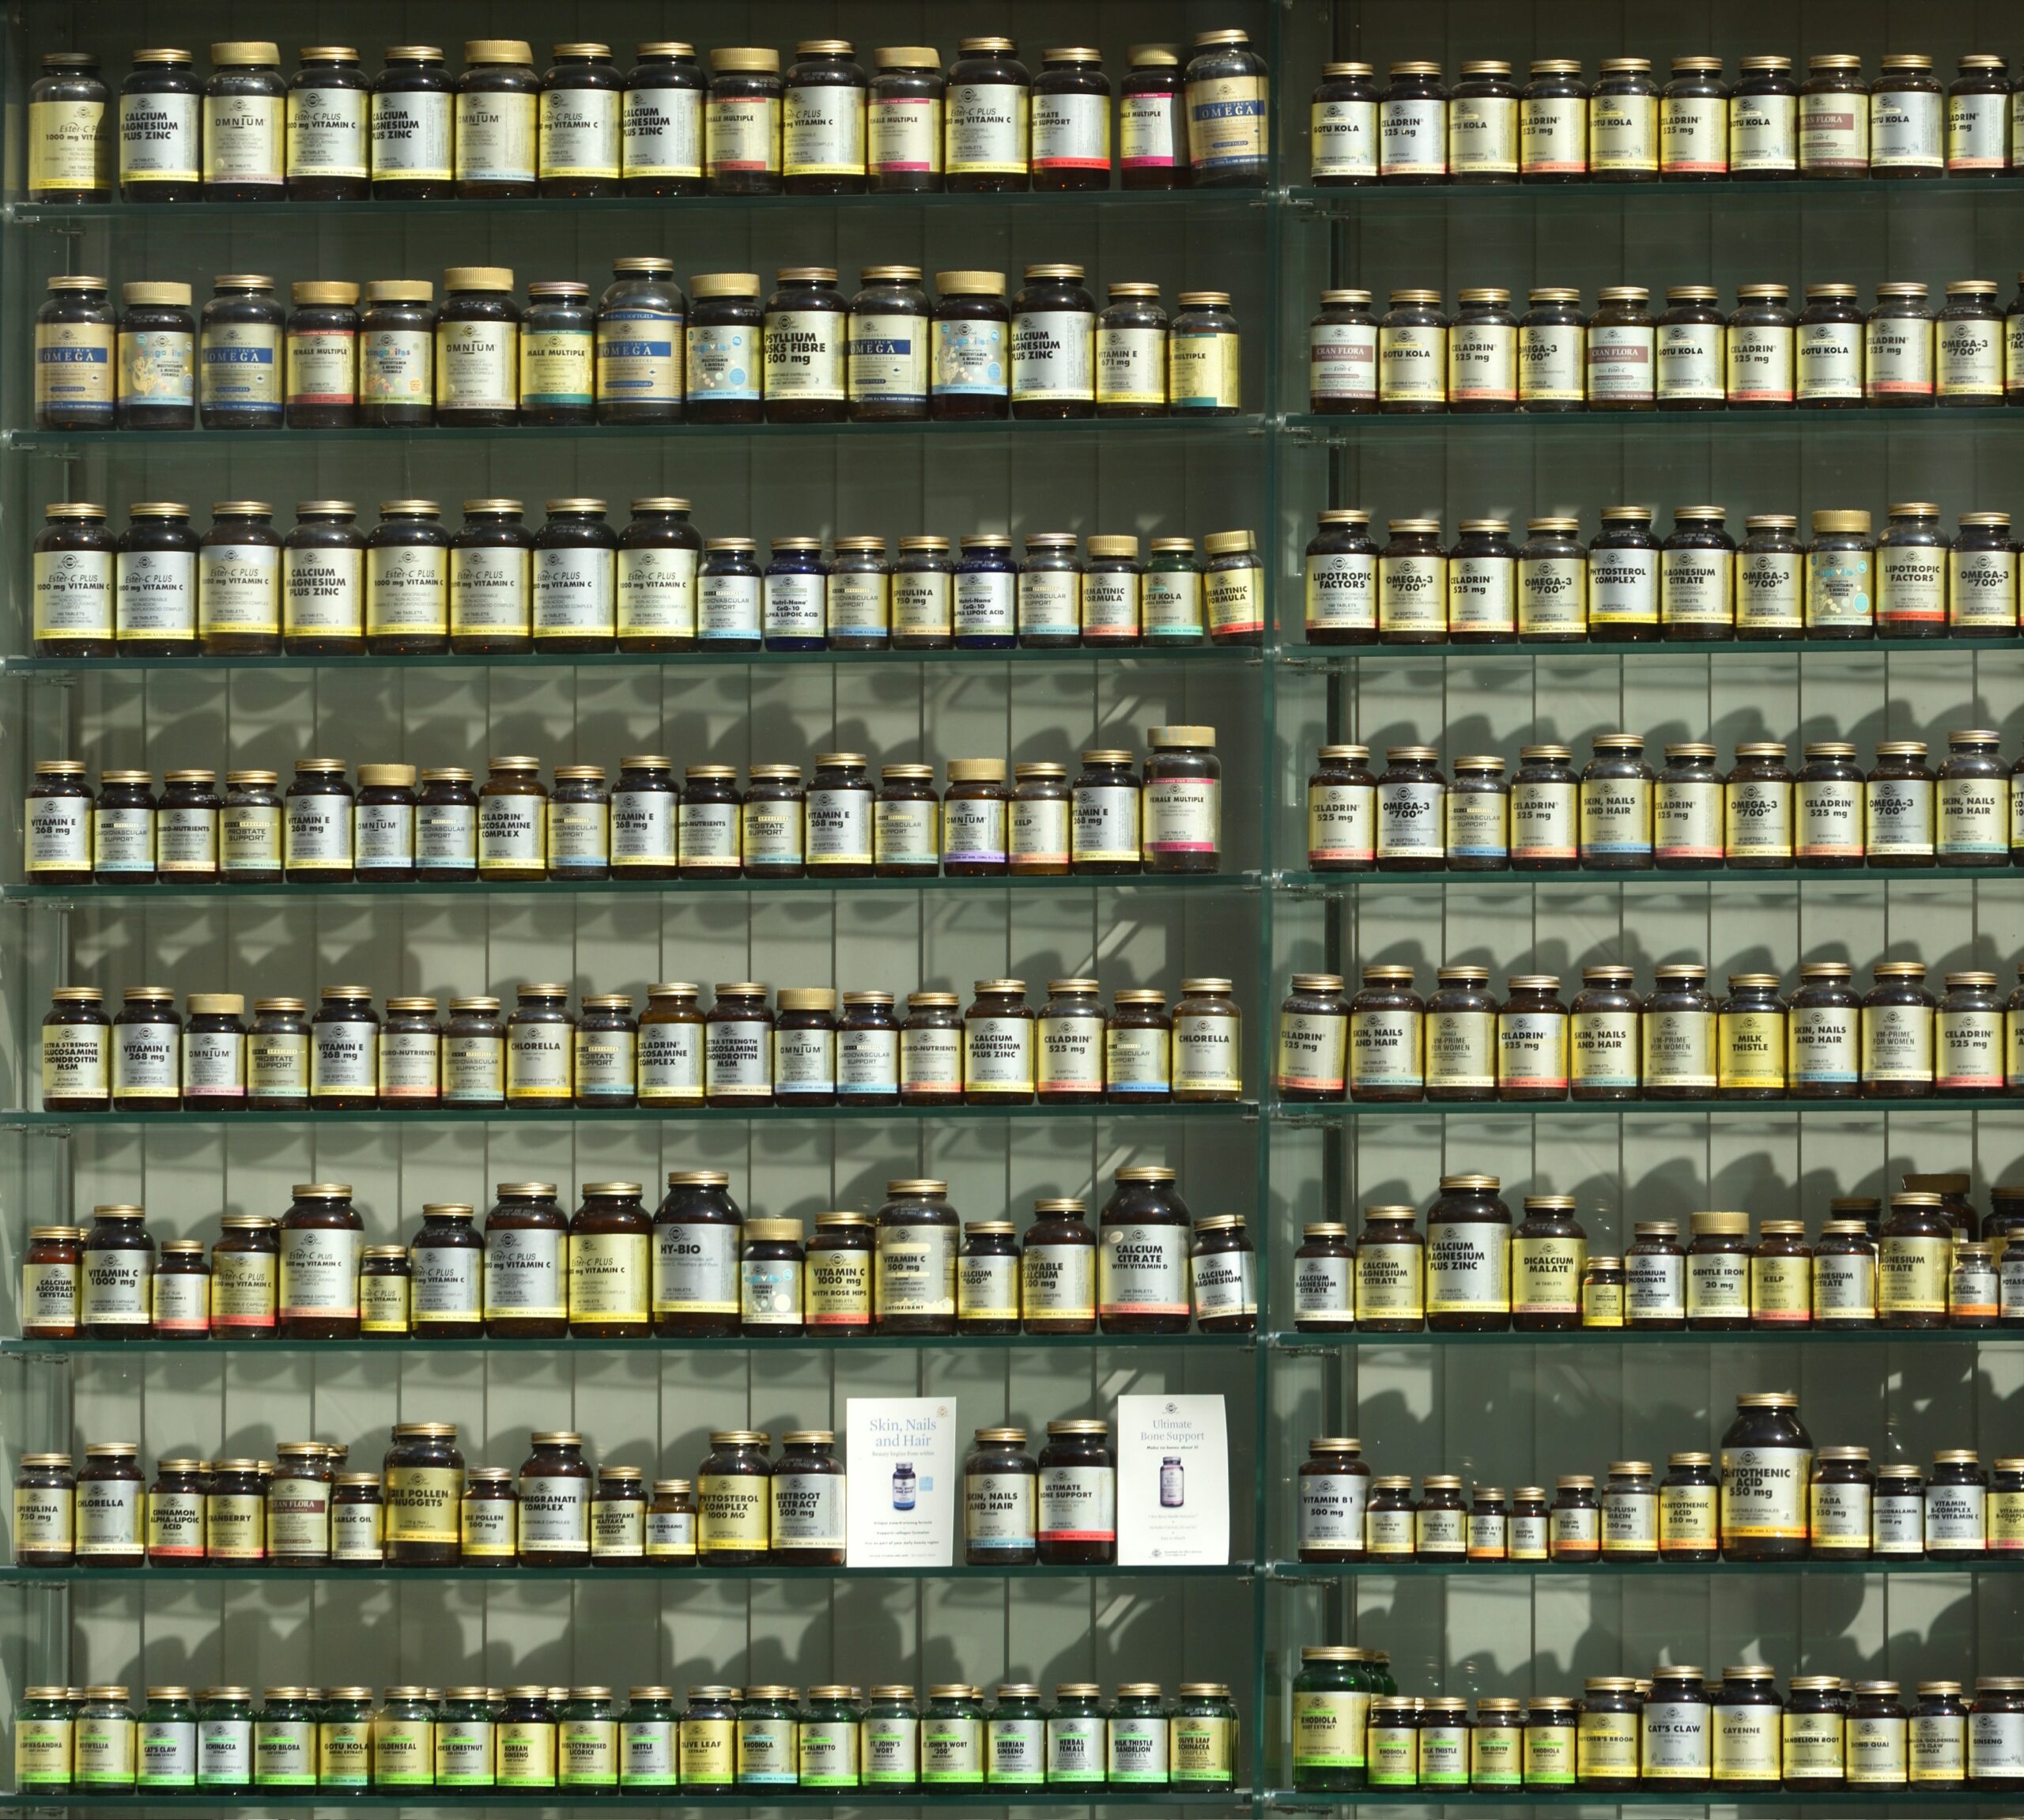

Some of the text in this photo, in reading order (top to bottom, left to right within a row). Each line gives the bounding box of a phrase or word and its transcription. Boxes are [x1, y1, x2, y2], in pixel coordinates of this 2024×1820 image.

[125, 111, 168, 122] CALCIUM
[1202, 107, 1255, 119] OMEGA
[214, 115, 265, 129] OMNIUM
[1334, 124, 1360, 133] KOLA
[1384, 127, 1417, 138] 525 mg
[123, 131, 172, 141] PLUS ZINC
[765, 332, 817, 343] PSYLLIUM
[790, 342, 826, 353] FIBRE
[1316, 347, 1365, 356] CRAN FLORA
[43, 352, 95, 362] OMEGA
[548, 349, 586, 357] MULTIPLE
[1098, 349, 1138, 358] VITAMIN E
[767, 353, 811, 365] 500 mg
[1116, 359, 1131, 368] mg
[48, 571, 98, 583] Ester-C PLUS
[291, 568, 335, 577] CALCIUM
[1312, 572, 1372, 582] LIPOTROPIC
[1589, 568, 1647, 576] PHYTOSTEROL
[285, 577, 346, 587] MAGNESIUM
[1319, 580, 1365, 589] FACTORS
[1386, 575, 1433, 585] OMEGA-3
[1594, 576, 1637, 585] COMPLEX
[69, 583, 102, 591] VITAMIN
[289, 587, 340, 597] PLUS ZINC
[893, 588, 934, 597] SPIRULINA
[1584, 796, 1636, 807] SKIN, NAILS
[1586, 806, 1631, 815] AND HAIR
[31, 818, 70, 827] VITAMIN
[35, 826, 70, 836] 268 mg
[511, 1042, 561, 1051] CHLORELLA
[1048, 1044, 1086, 1055] 525 mg
[1732, 1043, 1769, 1052] THISTLE
[43, 1048, 99, 1056] GLUCOSAMINE
[43, 1055, 98, 1064] CHONDROITIN
[660, 1244, 701, 1255] HY-BIO
[1116, 1244, 1163, 1255] CALCIUM
[1117, 1253, 1162, 1263] CITRATE
[1524, 1256, 1574, 1266] DICALCIUM
[88, 1269, 138, 1278] VITAMIN C
[813, 1267, 866, 1277] VITAMIN C
[1528, 1264, 1569, 1273] MALATE
[90, 1278, 136, 1288] 1000 mg
[817, 1276, 862, 1286] 1000 mg
[1705, 1281, 1734, 1291] 20 mg
[870, 1418, 936, 1433] Skin, Nails
[1154, 1420, 1191, 1429] Ultimate
[876, 1434, 931, 1447] and Hair
[1167, 1433, 1204, 1442] Support
[409, 1489, 449, 1499] POLLEN
[776, 1492, 821, 1501] BEETROOT
[1754, 1490, 1773, 1499] mg
[395, 1497, 443, 1507] NUGGETS
[777, 1500, 818, 1508] EXTRACT
[1303, 1496, 1339, 1505] VITAMIN
[1819, 1497, 1841, 1505] PABA
[779, 1508, 815, 1519] 500 mg
[1310, 1508, 1344, 1518] 500 mg
[1815, 1508, 1847, 1518] 550 mg
[358, 1515, 372, 1524] OIL
[1301, 1716, 1338, 1724] RHODIOLA
[1648, 1724, 1701, 1734] CAT'S CLAW
[346, 1742, 369, 1750] KOLA
[1851, 1740, 1869, 1749] DONG
